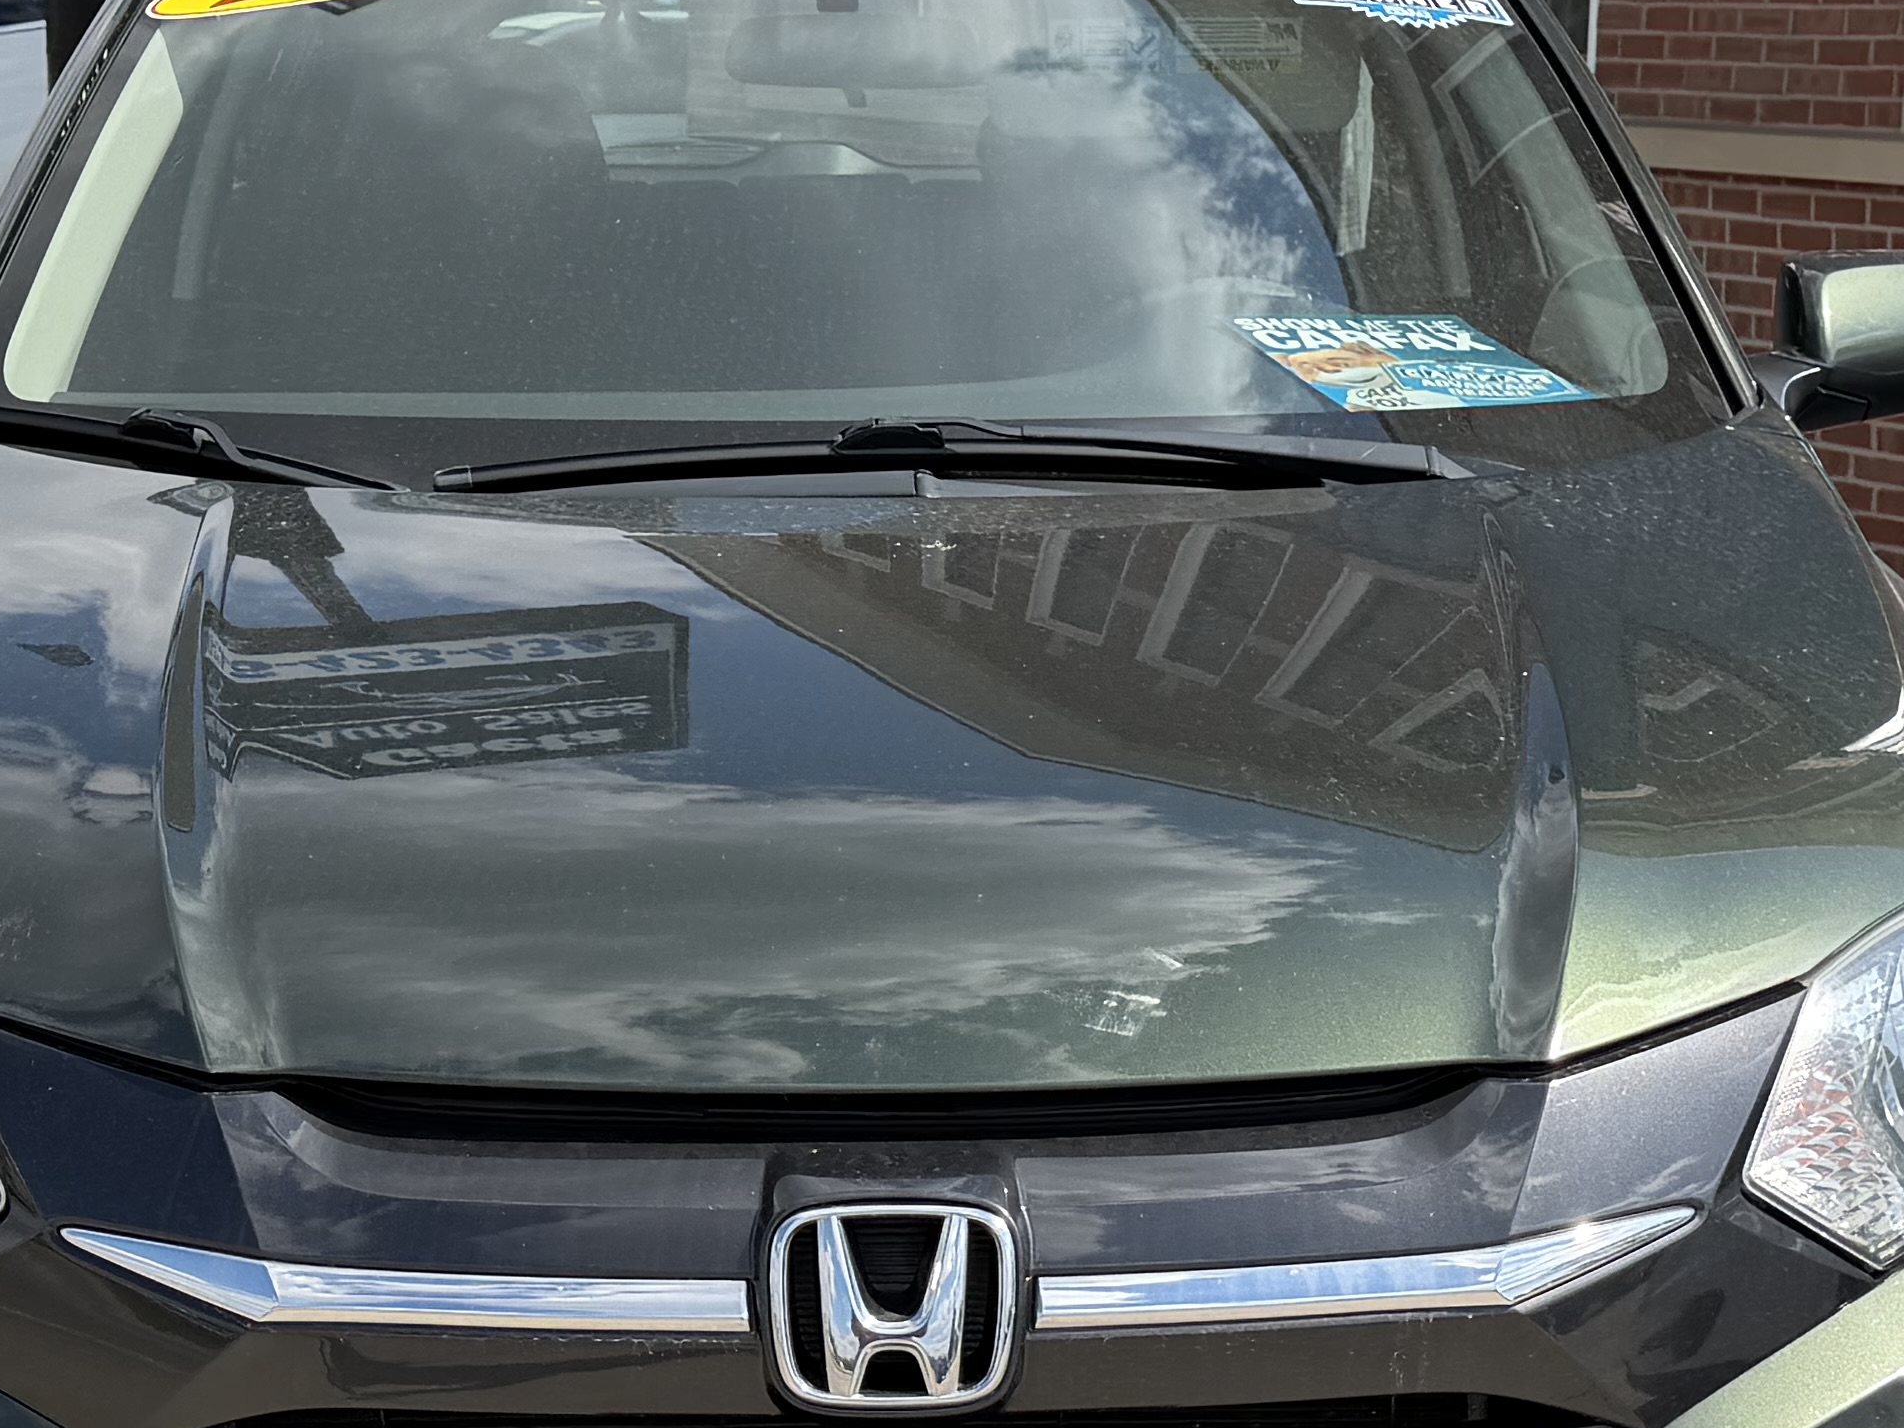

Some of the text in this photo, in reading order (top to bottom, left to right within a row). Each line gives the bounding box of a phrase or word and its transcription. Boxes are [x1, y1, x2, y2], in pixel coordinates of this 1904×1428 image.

[1233, 318, 1466, 334] SHOW ME THE
[1252, 329, 1497, 352] CARFAX
